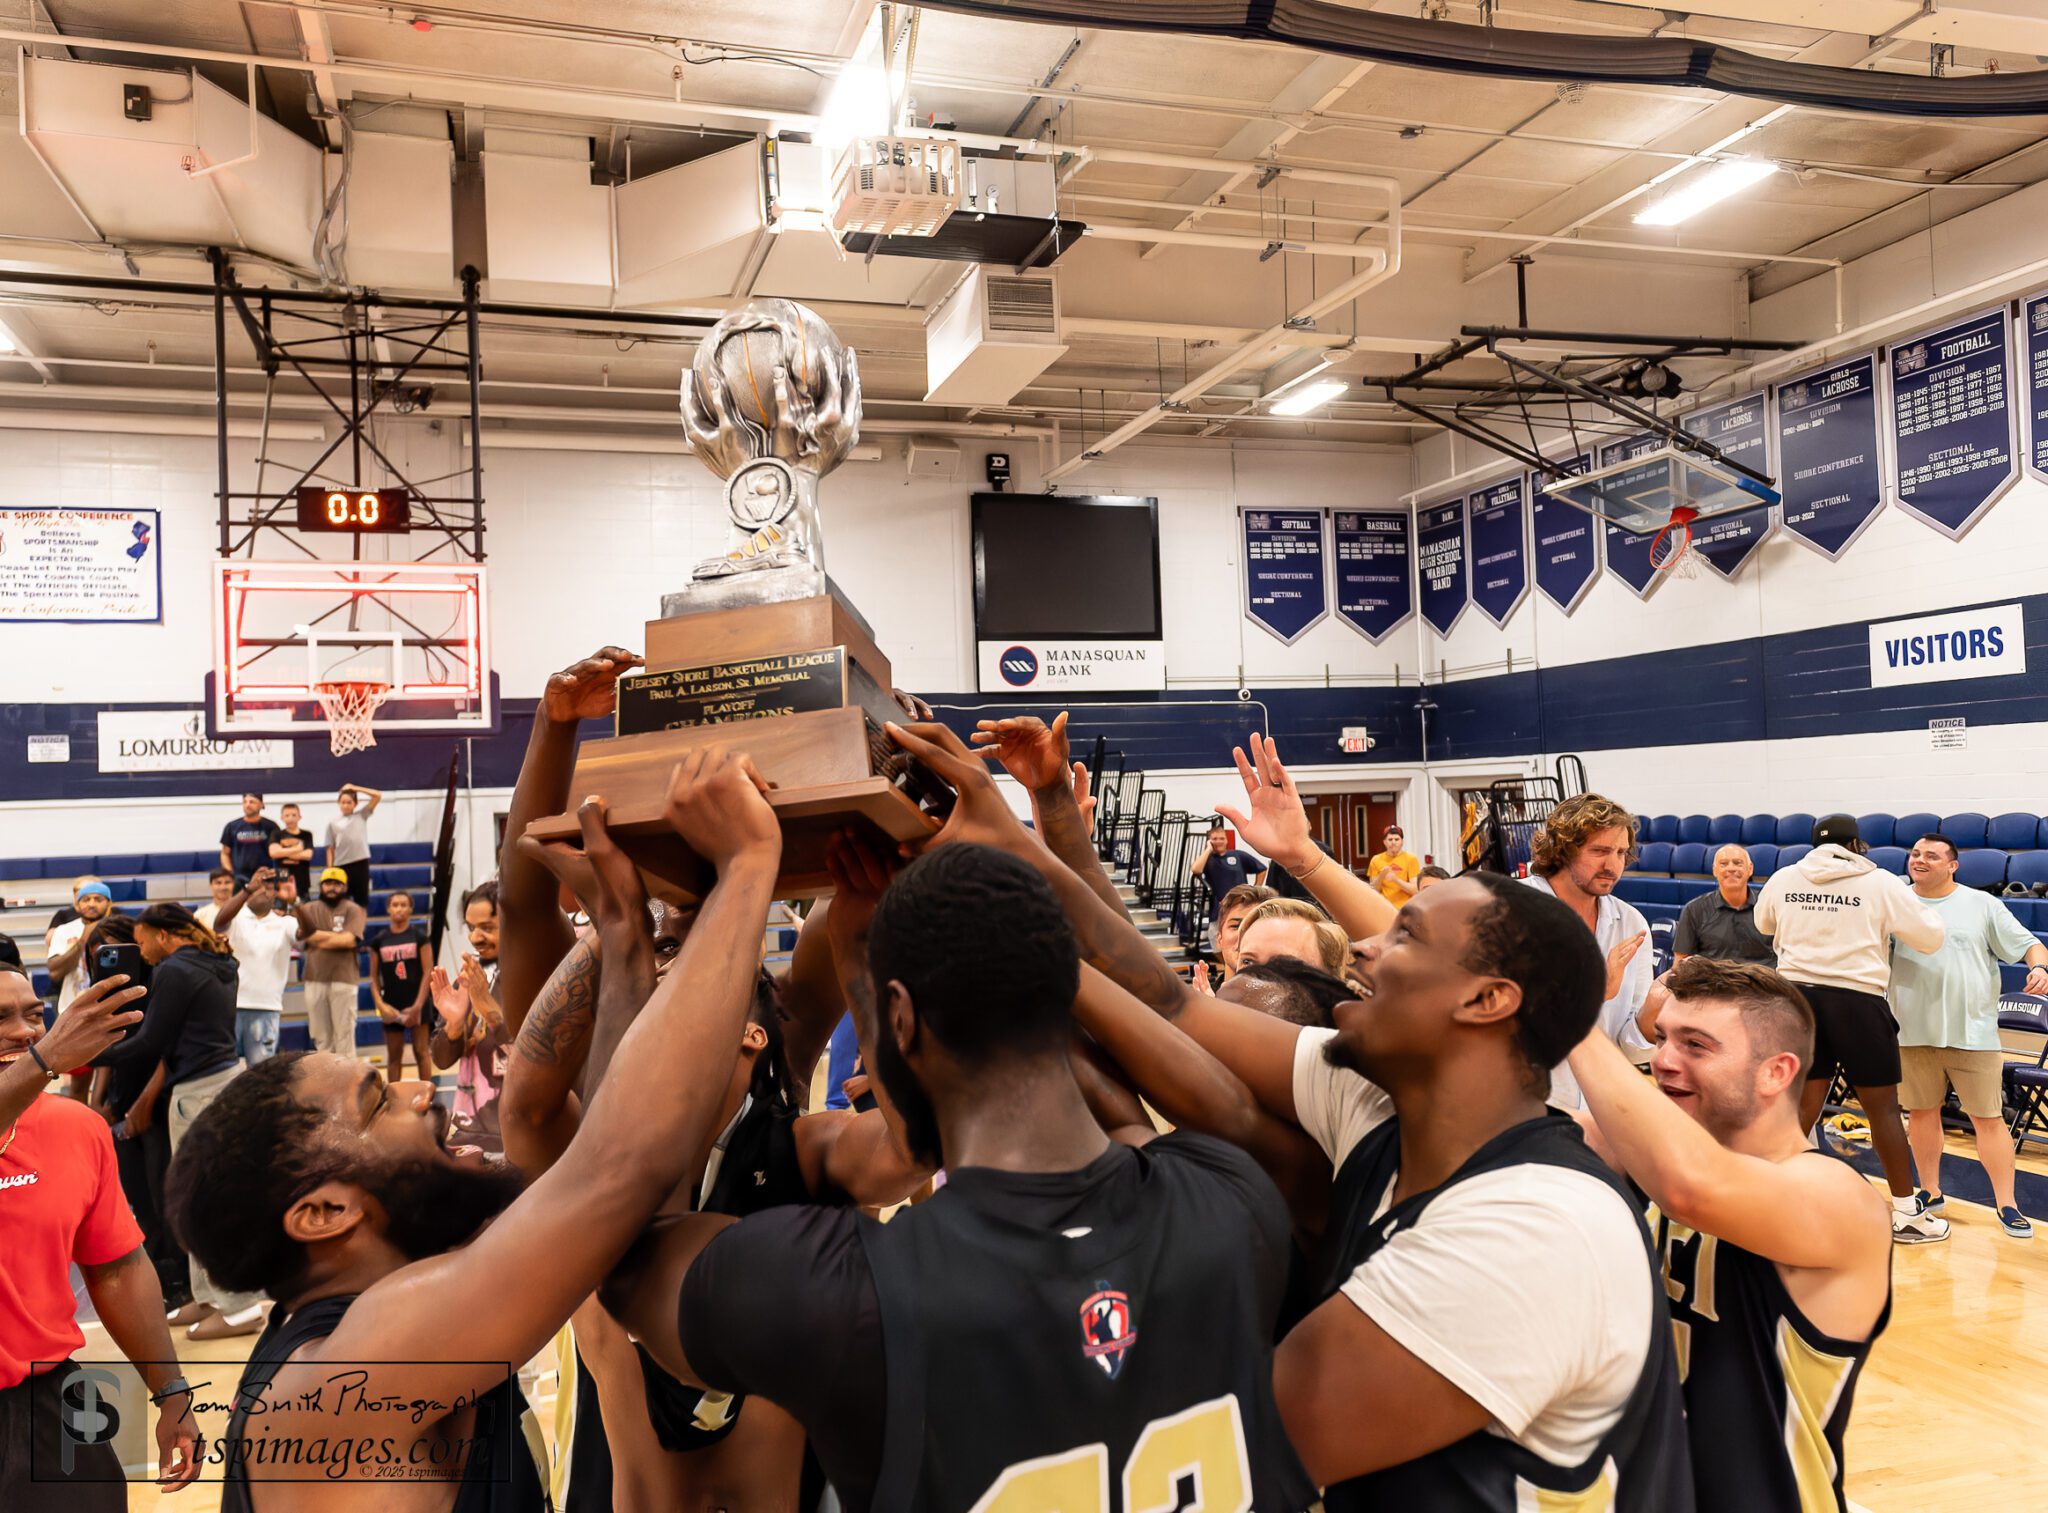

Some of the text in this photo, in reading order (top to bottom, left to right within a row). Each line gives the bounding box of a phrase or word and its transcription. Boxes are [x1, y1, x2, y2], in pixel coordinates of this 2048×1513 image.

[1941, 333, 1991, 360] FOOTBALL
[1830, 369, 1849, 383] GIRLS
[1929, 364, 1965, 383] DIVISION
[1822, 376, 1860, 398] LACROSSE
[1810, 403, 1841, 420] DIVISION
[1721, 411, 1753, 431] LACROSSE
[1928, 443, 1974, 462] SECTIONAL
[1794, 454, 1864, 481] SHORE CONFERENCE
[1491, 489, 1518, 506] VOLLEYBALL
[1811, 493, 1851, 510] SECTIONAL
[14, 511, 53, 520] SHORE
[59, 511, 135, 520] CONFERENCE
[328, 494, 379, 524] 0.0
[1441, 510, 1454, 523] BAND
[1281, 520, 1311, 529] SOFTBALL
[1366, 521, 1401, 531] BASEBALL
[1711, 519, 1744, 534] SECTIONAL
[1419, 535, 1461, 558] MANASQUAN
[1420, 549, 1462, 570] HIGH SCHOOL
[1426, 562, 1457, 581] WARRIOR
[1432, 577, 1452, 591] BAND
[1886, 626, 2004, 667] VISITORS
[1046, 650, 1146, 662] MANASQUAN
[626, 652, 836, 691] JERSEY SHORE BASKETBALL LEAGUE
[1047, 664, 1092, 676] BANK
[649, 689, 674, 701] PAUL
[754, 671, 811, 686] MEMORIAL
[703, 699, 757, 716] PLAYOFF
[1932, 718, 1963, 729] NOTICE
[1347, 737, 1365, 751] EXIT
[1785, 892, 1861, 907] ESSENTIALS
[1997, 1001, 2043, 1016] MANASQUAN
